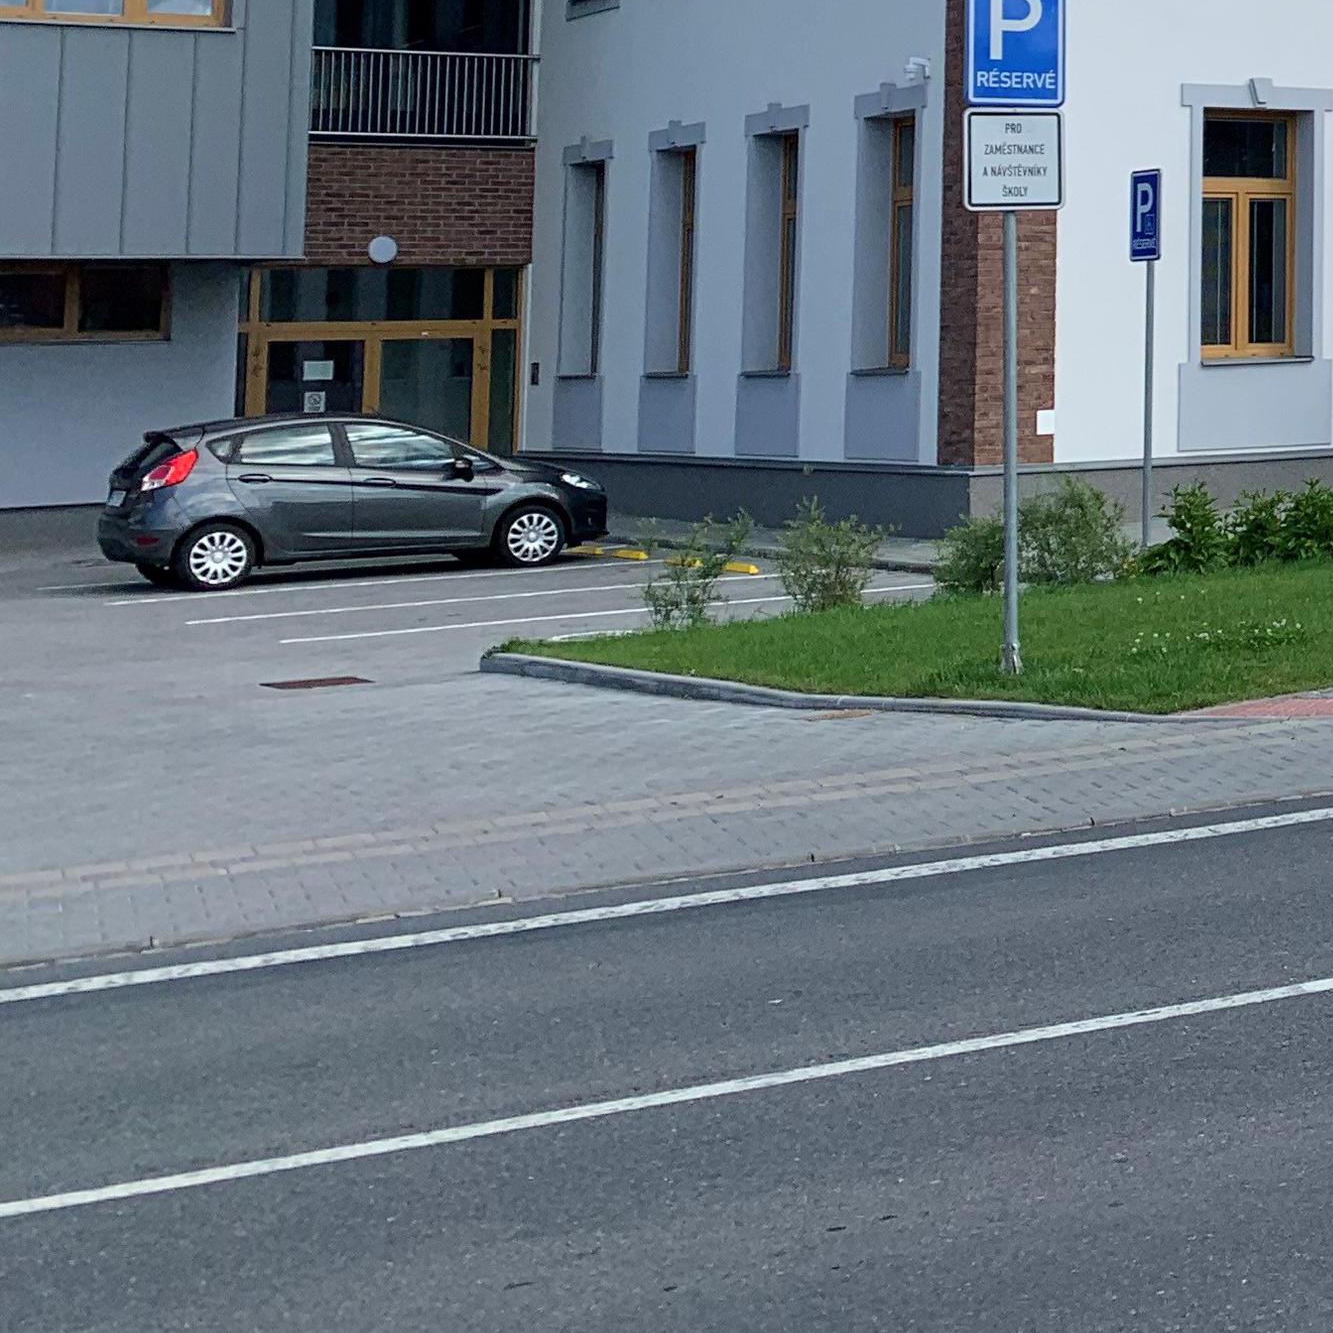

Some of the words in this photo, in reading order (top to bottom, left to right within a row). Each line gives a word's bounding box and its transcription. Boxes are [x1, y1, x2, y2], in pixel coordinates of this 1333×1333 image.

[976, 68, 1056, 89] RÉSERVÉ
[1005, 123, 1022, 134] PRO
[982, 167, 988, 177] A
[1002, 184, 1028, 197] ŠKOLY
[1136, 182, 1153, 232] P
